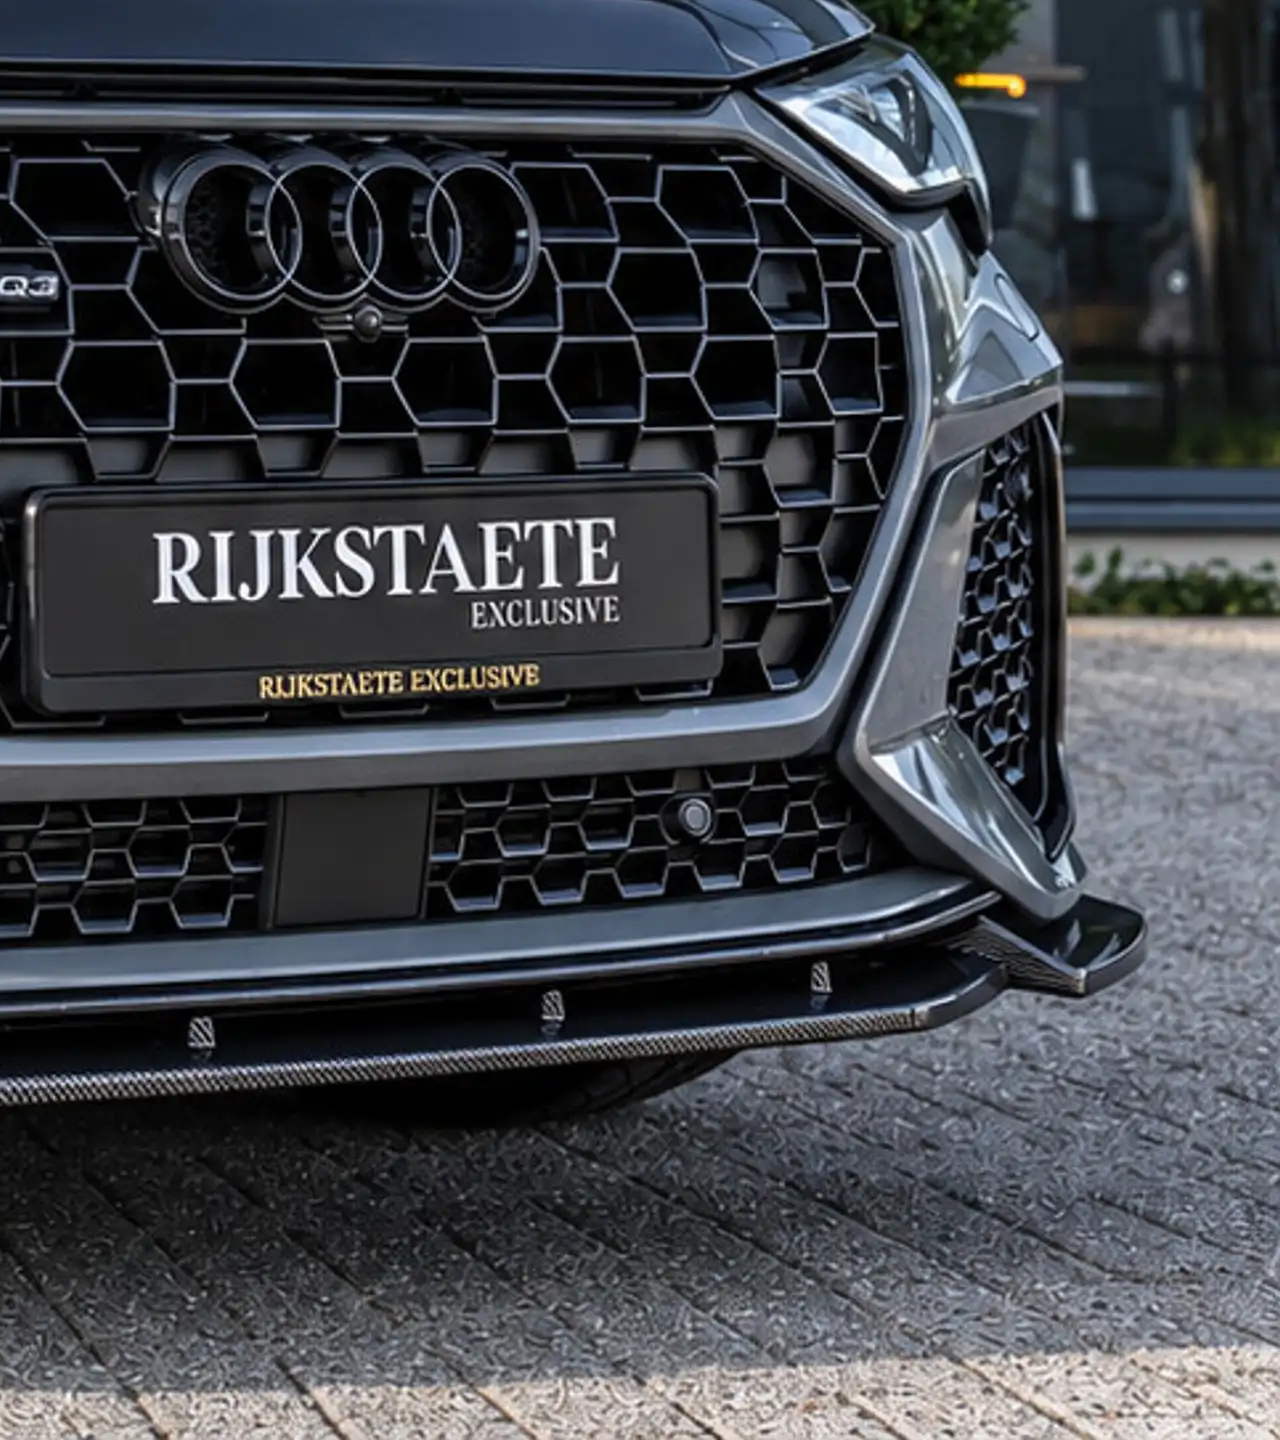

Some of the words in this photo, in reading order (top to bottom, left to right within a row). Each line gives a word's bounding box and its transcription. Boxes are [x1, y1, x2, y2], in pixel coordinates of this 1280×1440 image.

[151, 516, 621, 605] RIJKSTAETE
[470, 596, 621, 630] EXCLUSIVE
[258, 670, 405, 701] RIJKSTAETE
[410, 663, 541, 692] EXCLUSIVE
